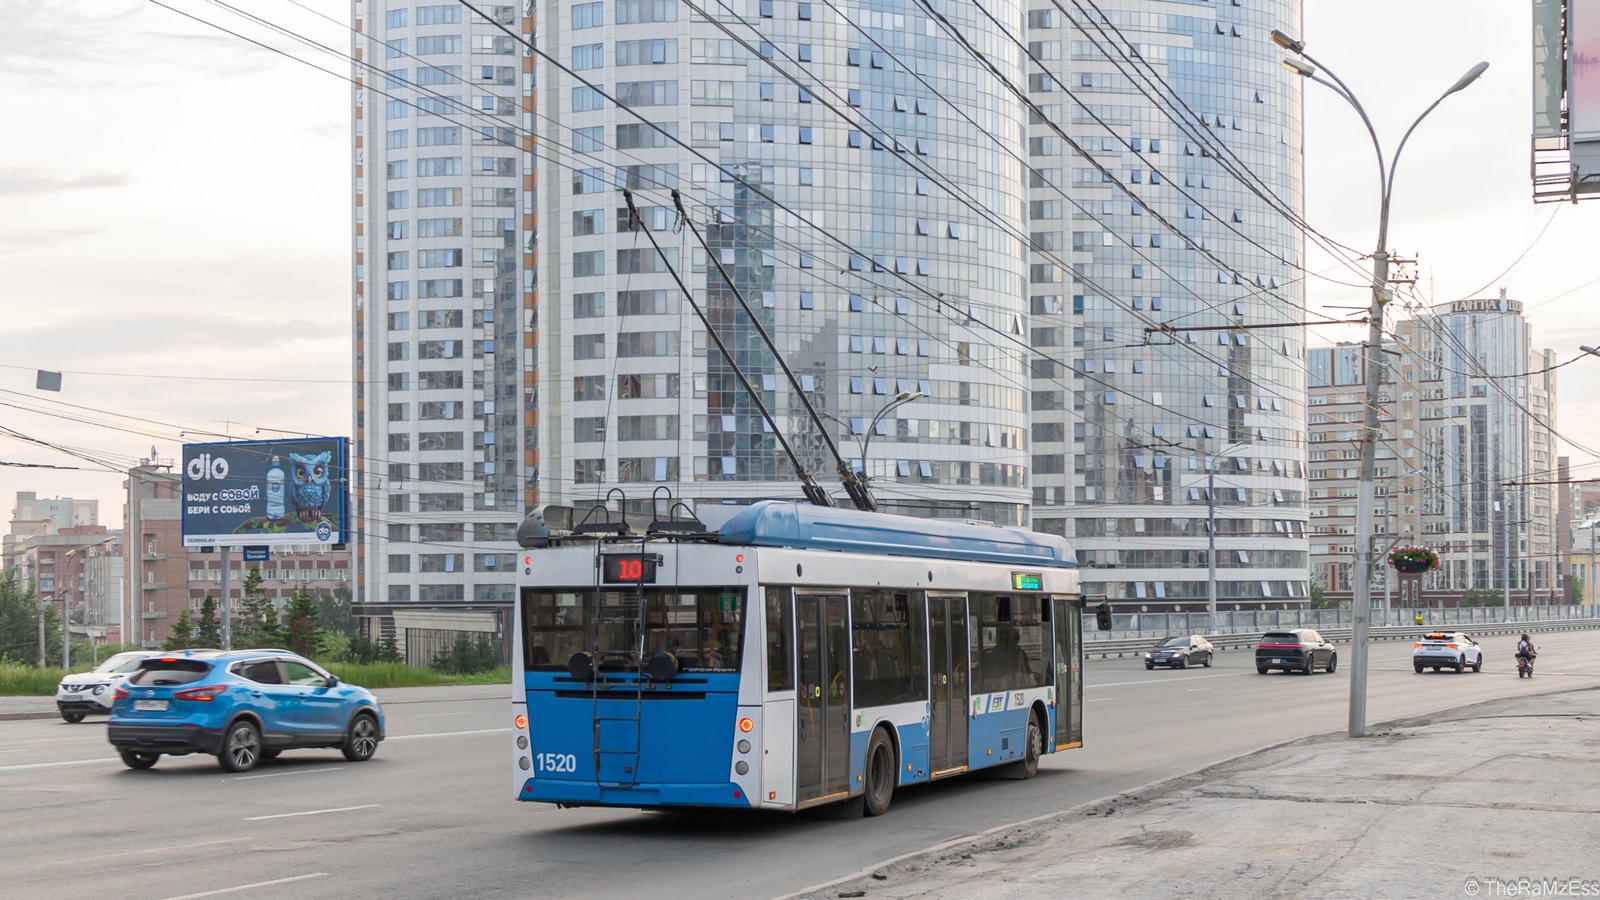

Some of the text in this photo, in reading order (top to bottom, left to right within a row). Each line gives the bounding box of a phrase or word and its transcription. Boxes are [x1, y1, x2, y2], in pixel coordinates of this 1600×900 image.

[187, 452, 229, 481] dio
[187, 493, 211, 503] ВОДУ
[219, 485, 260, 501] СОВОЙ
[187, 505, 210, 514] БЕРИ
[220, 503, 251, 514] СОБОЙ
[619, 560, 642, 579] 10
[1014, 692, 1025, 706] 1520
[536, 753, 577, 773] 1520
